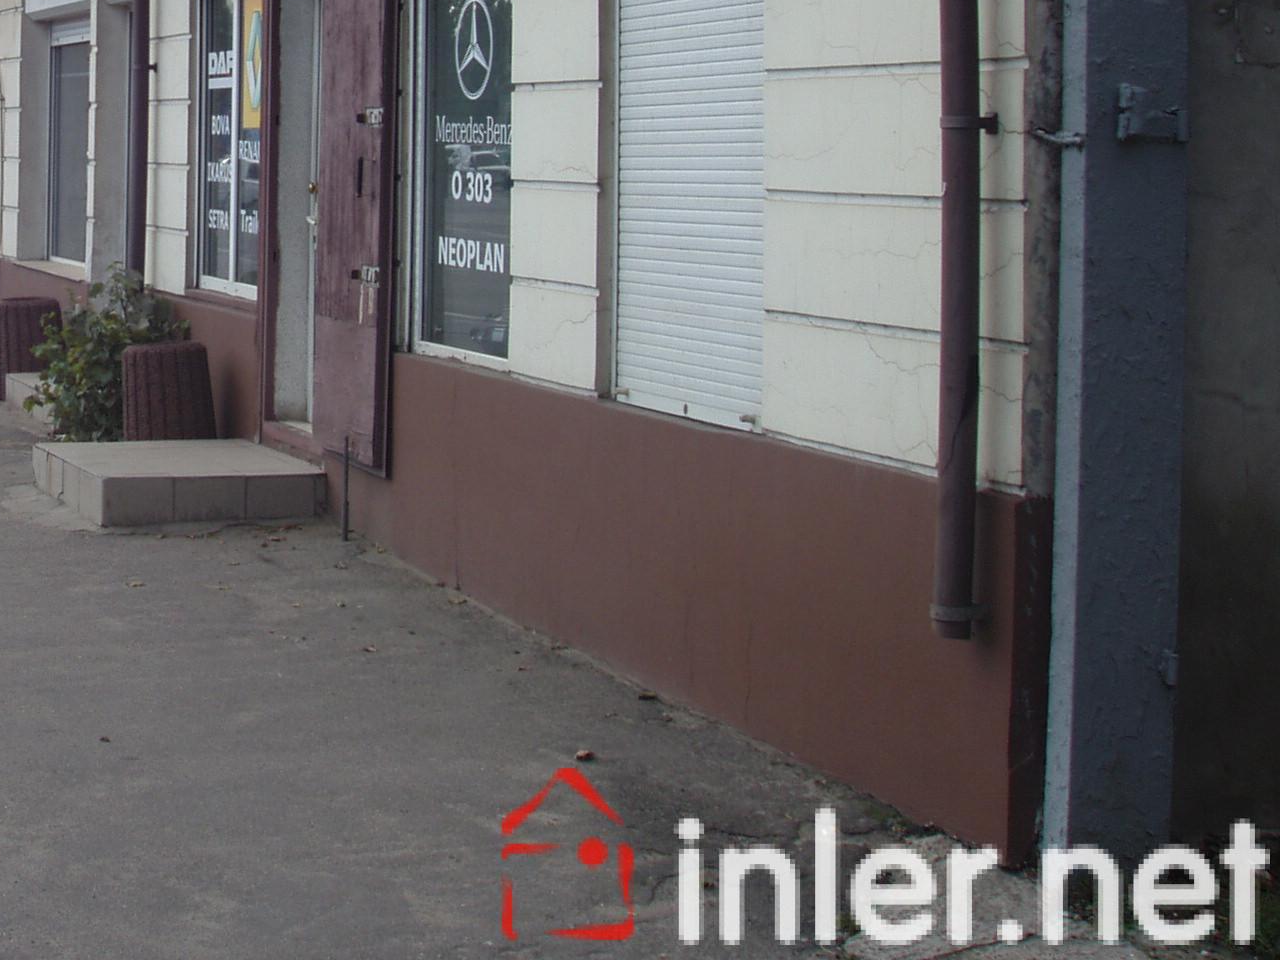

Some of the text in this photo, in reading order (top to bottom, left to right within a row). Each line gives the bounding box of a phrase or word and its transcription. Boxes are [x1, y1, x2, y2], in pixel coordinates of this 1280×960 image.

[212, 115, 230, 135] BOVA
[436, 115, 511, 145] Mercedes-Benz
[466, 172, 492, 203] 303
[208, 209, 229, 229] SETRA
[438, 236, 504, 273] NEOPLAN
